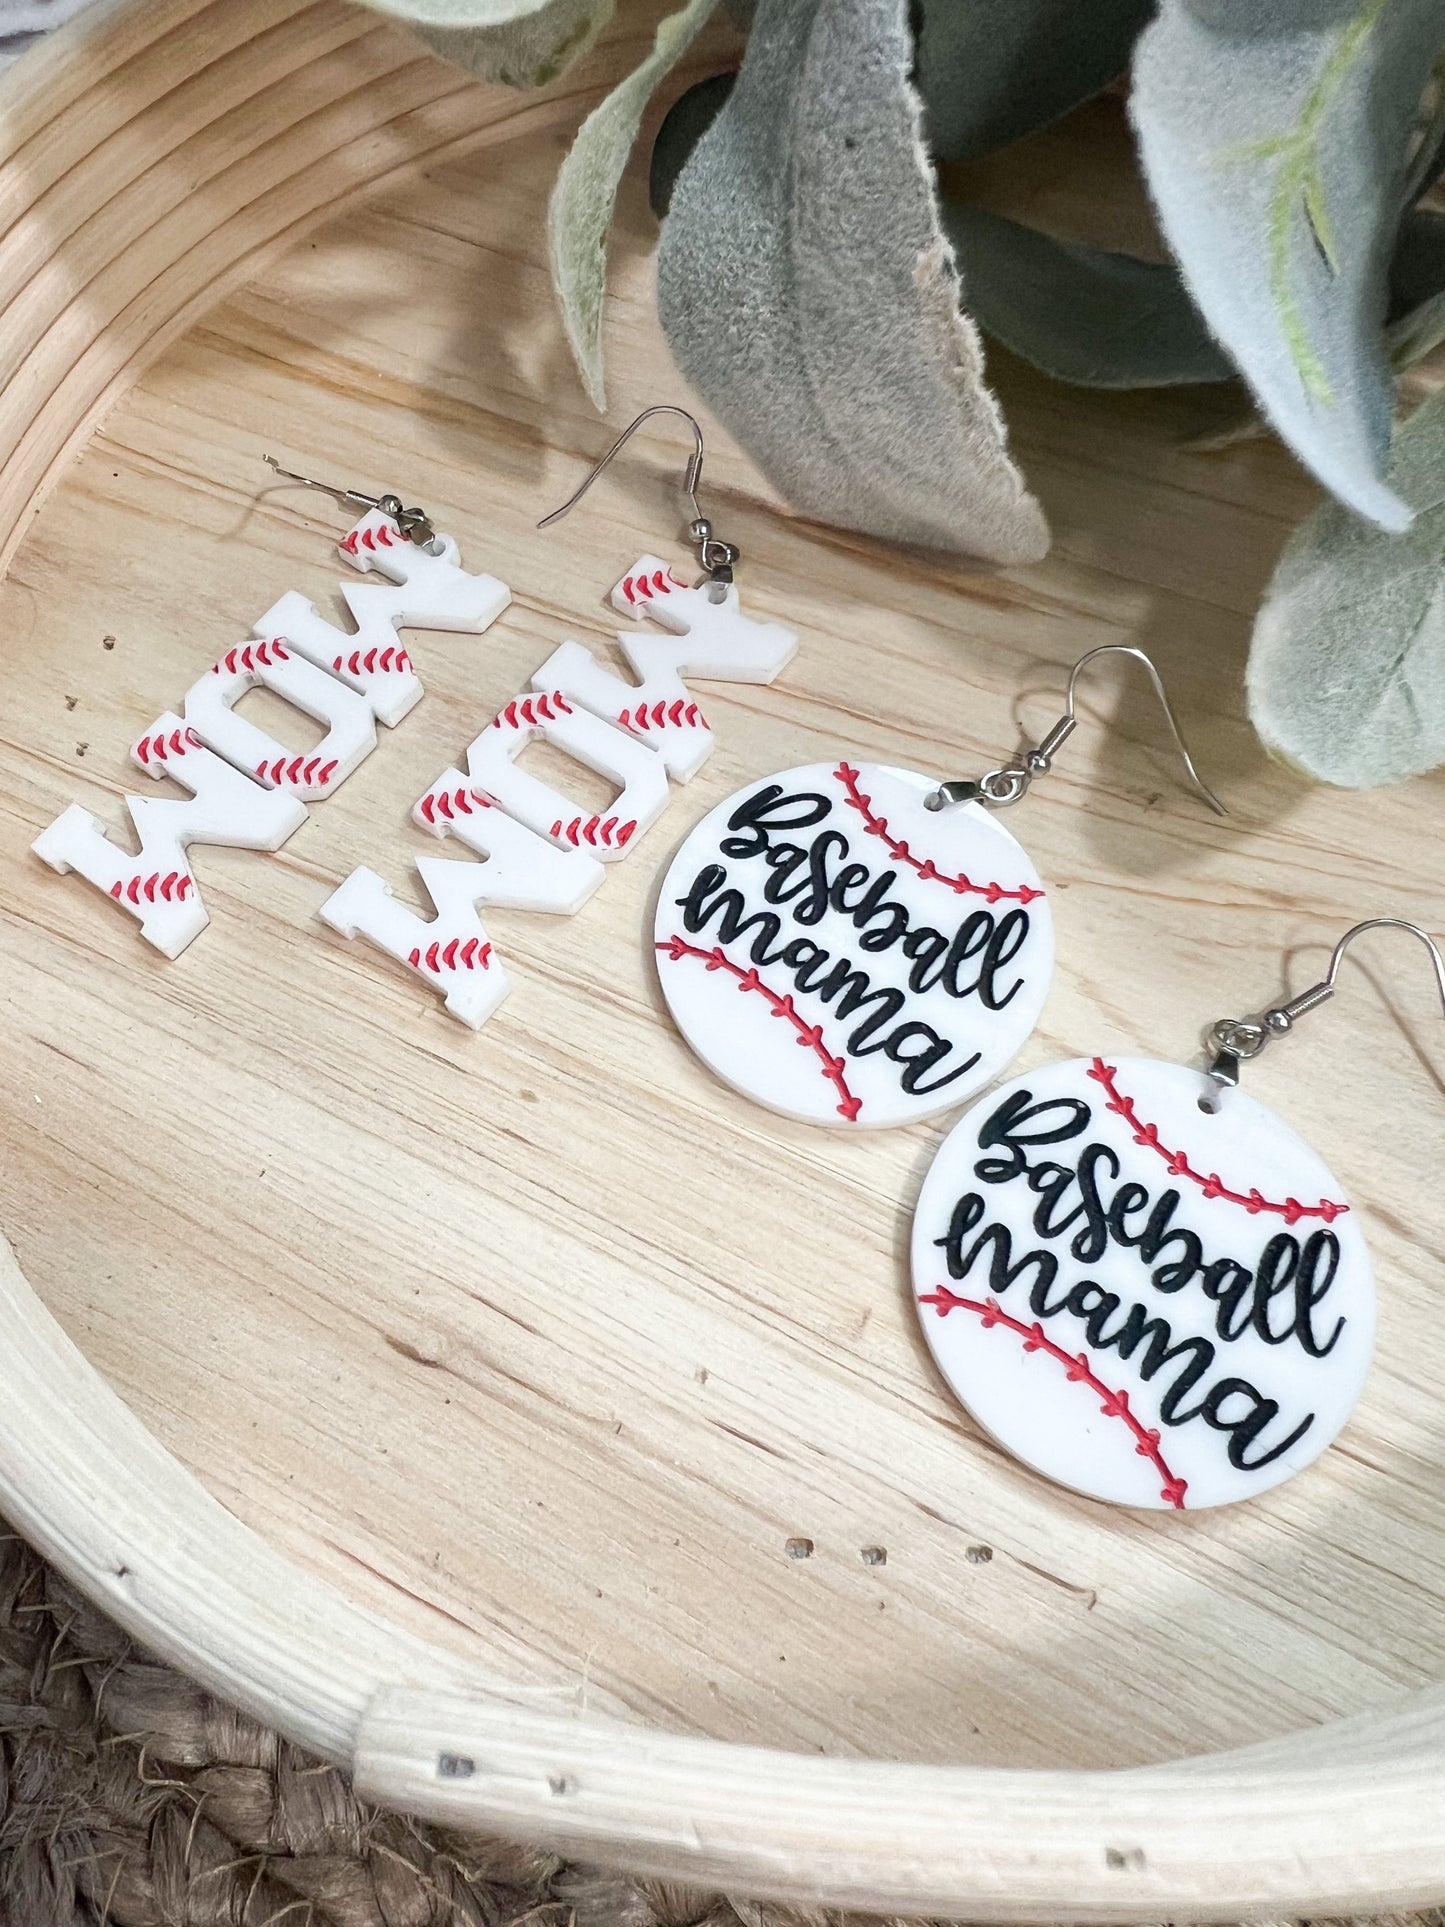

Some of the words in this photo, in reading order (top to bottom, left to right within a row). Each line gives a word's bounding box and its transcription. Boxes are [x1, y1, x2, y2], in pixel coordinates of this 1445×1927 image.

[33, 510, 511, 959] MOM
[321, 554, 798, 1030] MOM
[675, 864, 982, 1095] mama
[719, 784, 1029, 1011] Baseball
[934, 1193, 1314, 1471] mama
[974, 1089, 1346, 1358] Baseball
